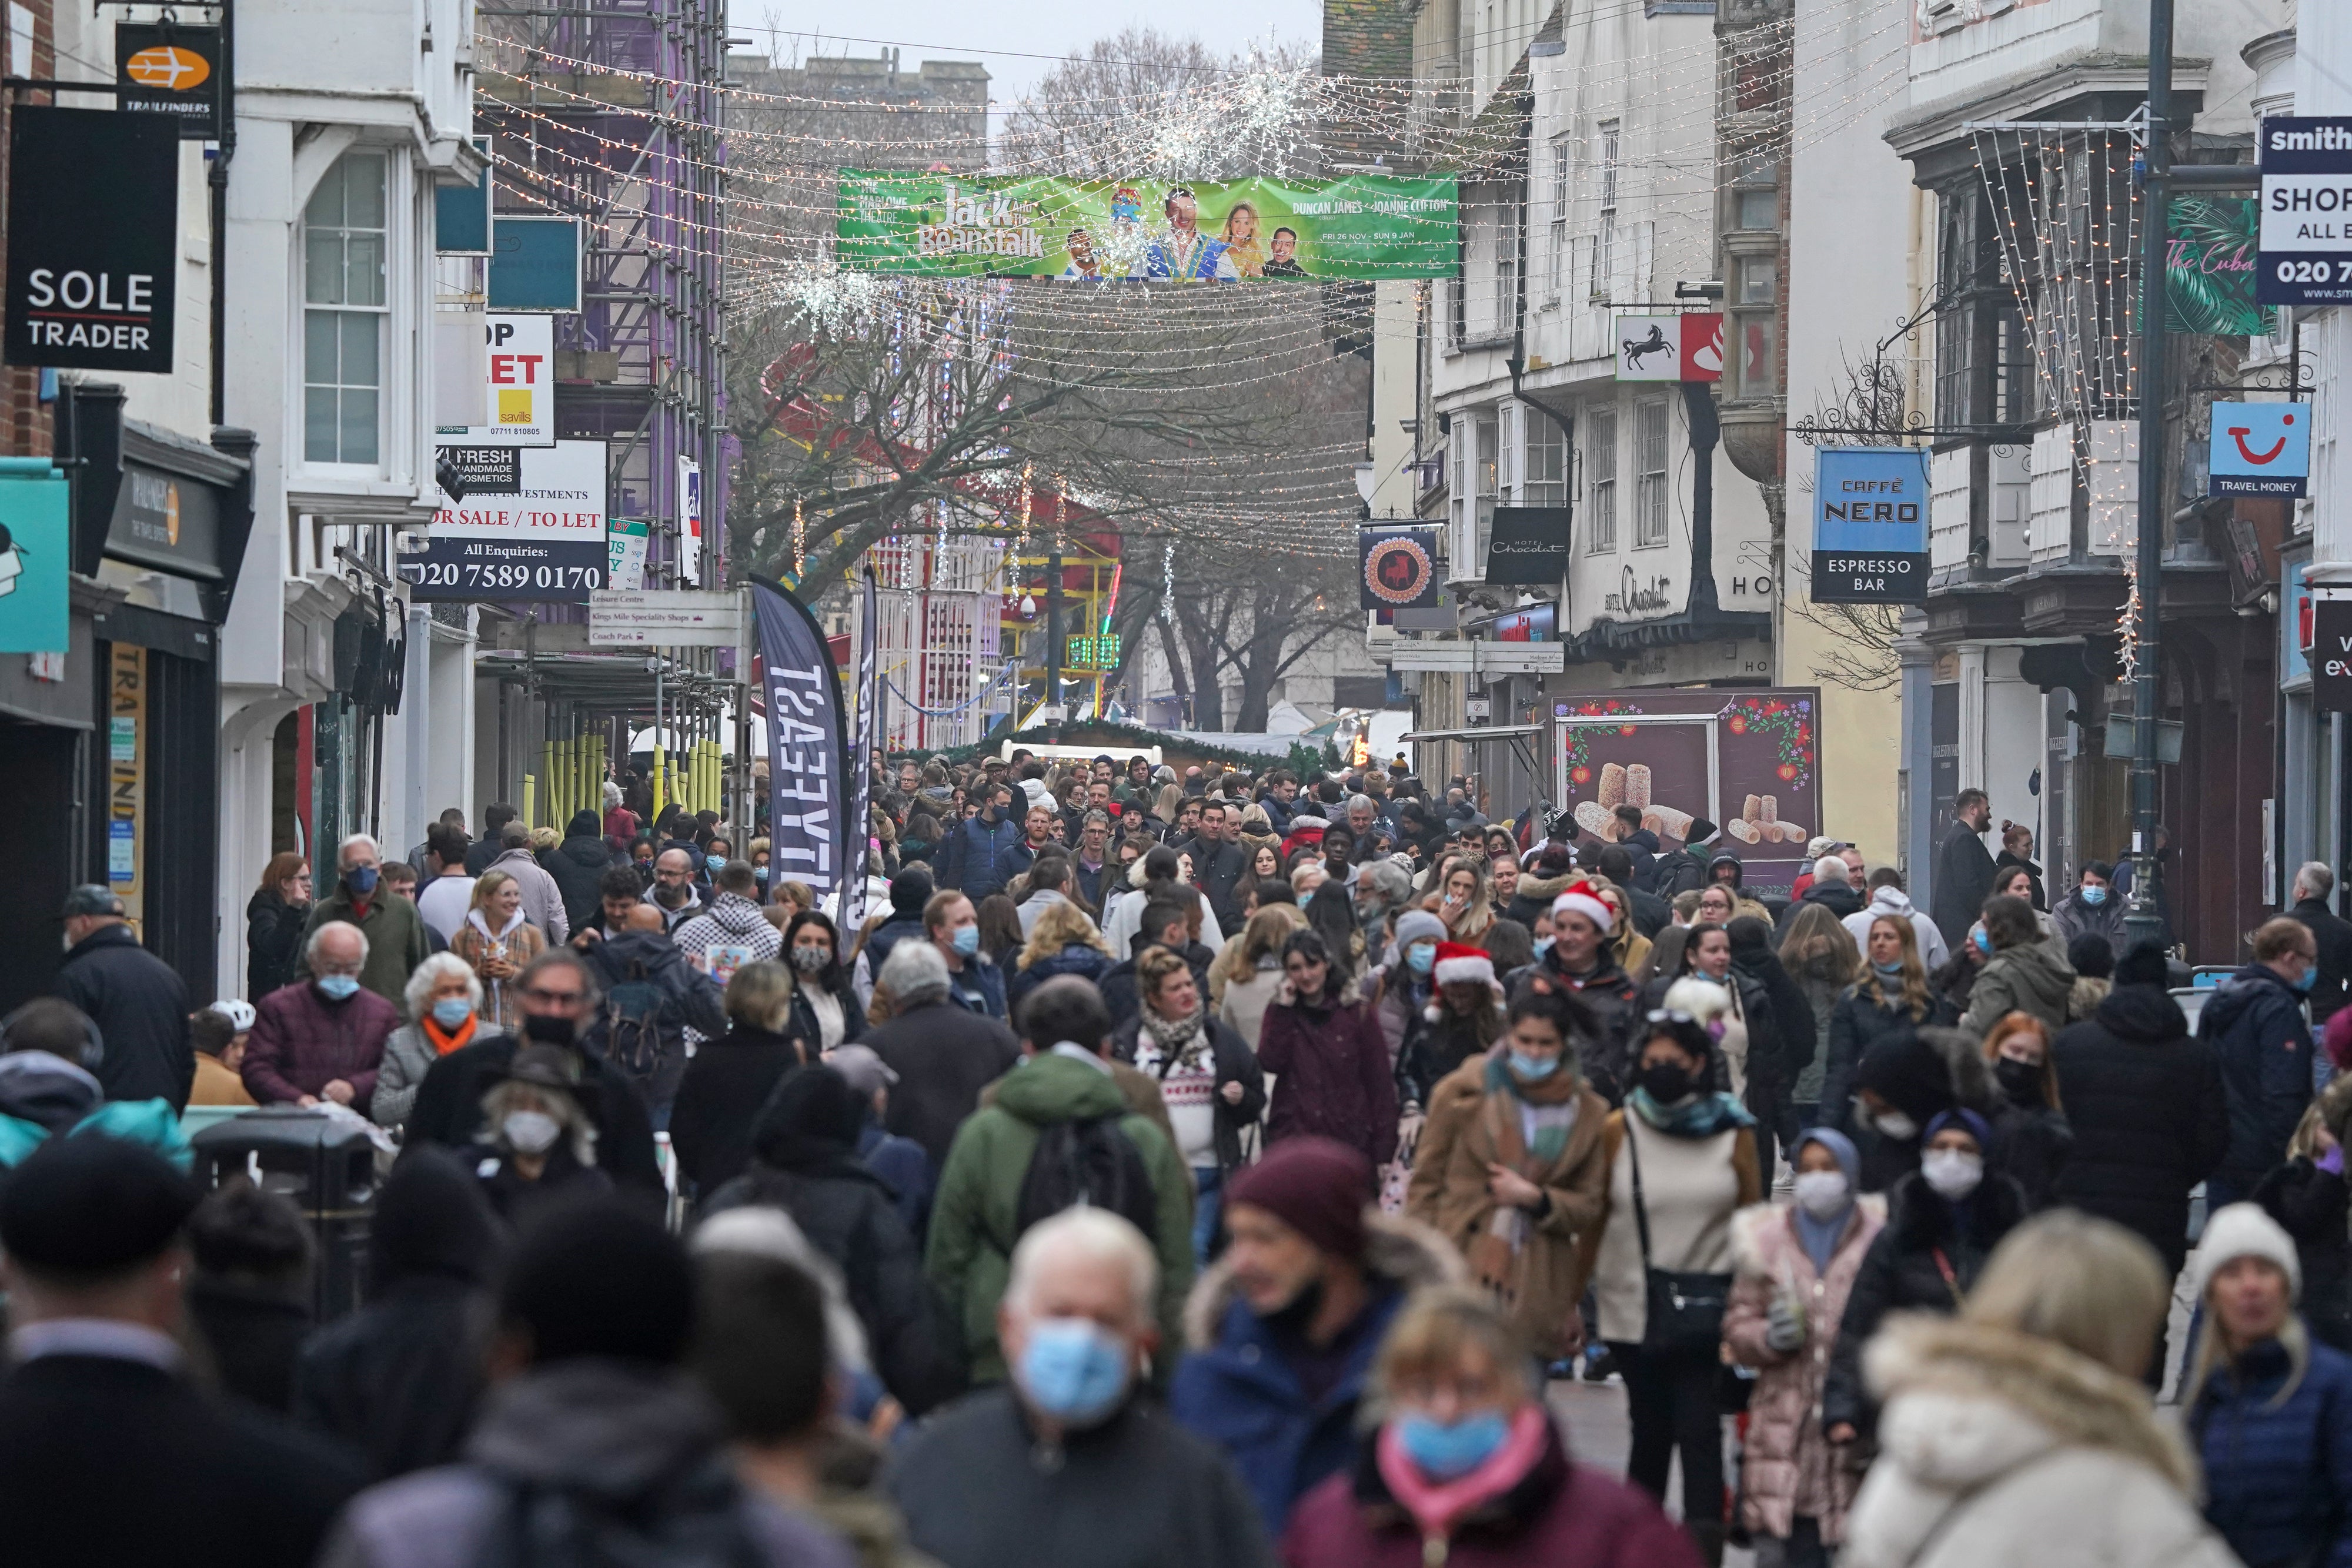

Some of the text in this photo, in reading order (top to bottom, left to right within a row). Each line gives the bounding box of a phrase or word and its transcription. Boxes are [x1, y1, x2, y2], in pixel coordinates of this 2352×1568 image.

[126, 101, 211, 113] TRAILFINDERS
[860, 178, 878, 193] THE
[936, 183, 1013, 228] Jack
[1293, 201, 1362, 215] DUNCAN JAMES
[1372, 199, 1447, 213] JOANNE CLIFTON
[860, 210, 898, 222] THEATRE
[2297, 223, 2335, 239] ALL
[918, 225, 1044, 257] Beanstalk
[2165, 239, 2197, 269] The
[2277, 262, 2352, 282] 020 7
[28, 268, 153, 313] SOLE
[27, 320, 150, 350] TRADER
[487, 355, 543, 384] ET
[500, 412, 532, 423] savills
[457, 450, 512, 463] FRESH
[1842, 477, 1904, 494] CAFFÈ
[2220, 481, 2297, 493] TRAVEL MONEY
[459, 510, 509, 526] SALE
[528, 511, 557, 527] TO
[563, 512, 600, 528] LET
[1824, 500, 1919, 523] NERO
[614, 521, 630, 532] BY
[464, 544, 548, 559] All Enquiries:
[1828, 559, 1911, 573] ESPRESSO
[465, 564, 529, 589] 7589
[536, 566, 600, 590] 0170
[1854, 577, 1885, 591] BAR
[1605, 593, 1622, 611] HOTEL
[592, 613, 611, 621] Kings
[632, 613, 665, 622] Speciality
[668, 614, 689, 623] Shops
